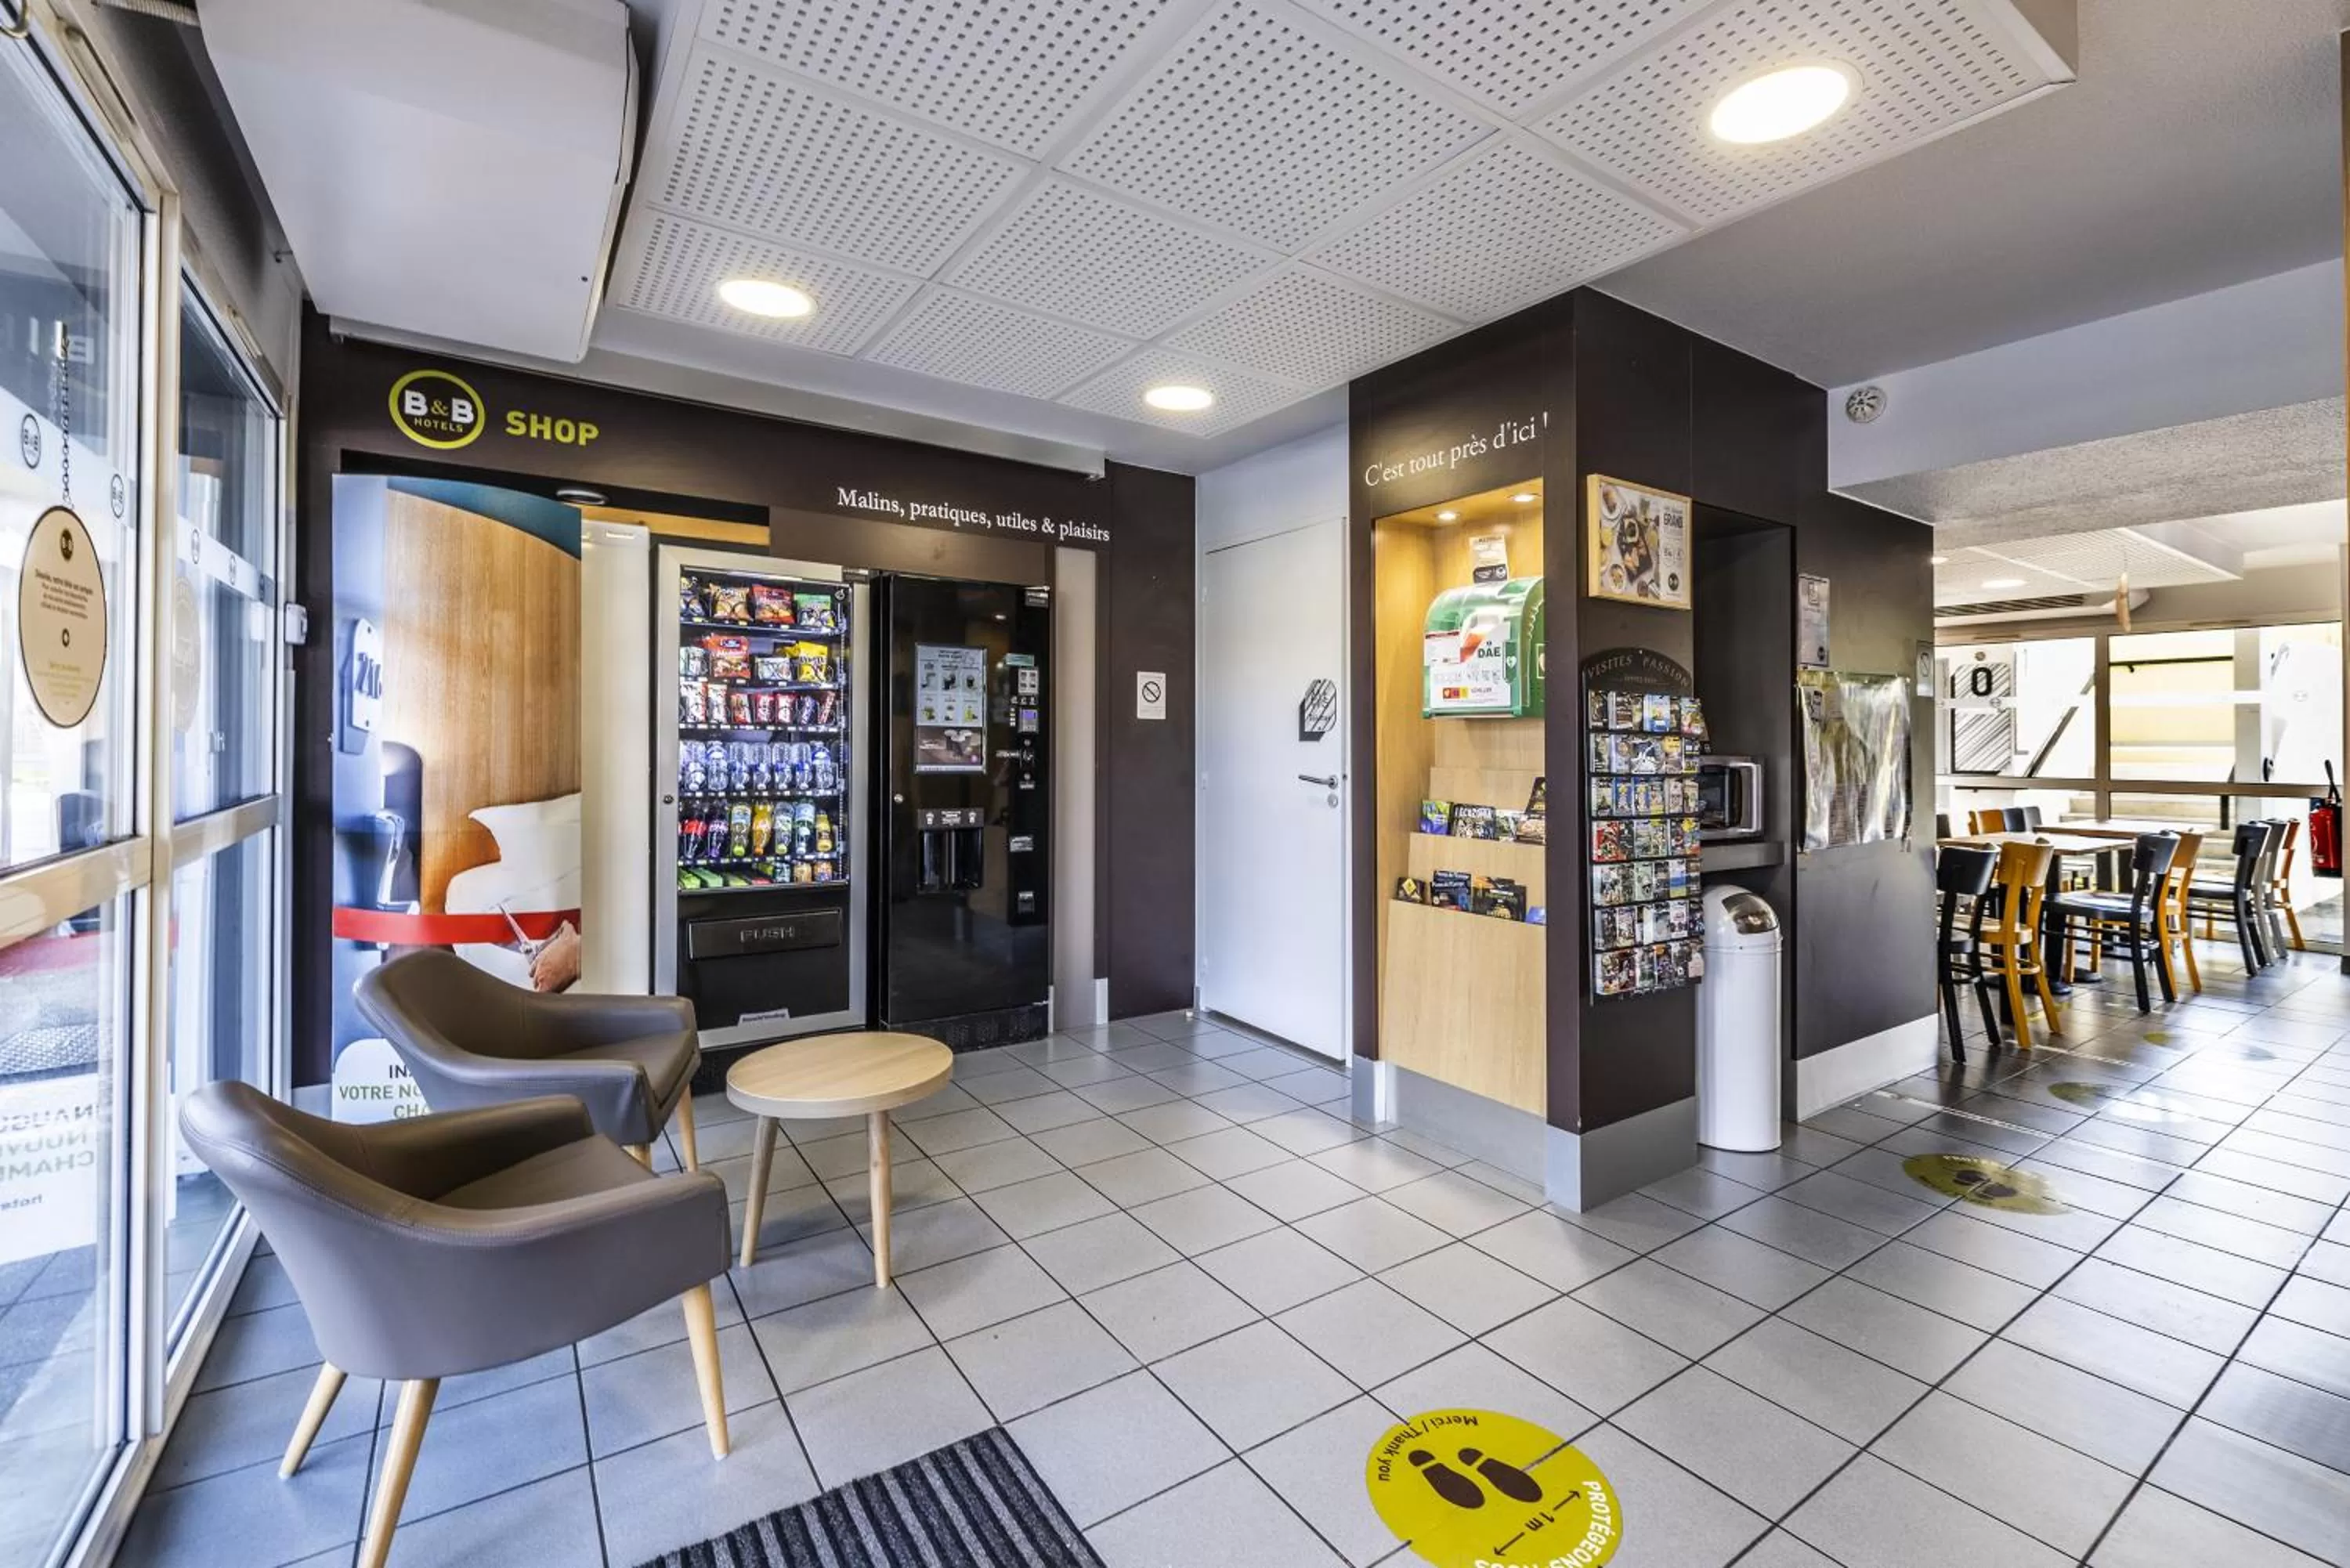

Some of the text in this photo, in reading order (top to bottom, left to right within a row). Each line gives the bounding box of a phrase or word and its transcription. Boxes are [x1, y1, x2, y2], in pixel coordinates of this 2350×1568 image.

[404, 389, 474, 424] B&B
[414, 417, 463, 433] HOTELS
[505, 410, 599, 446] SHOP
[1365, 462, 1405, 486] C'est
[1410, 450, 1445, 474] tout
[1450, 434, 1487, 468] près
[1492, 416, 1537, 449] d'ici
[837, 486, 1111, 542] Malins, pratiques, utiles & plaisirs
[1477, 647, 1502, 659] DAE
[1587, 654, 1689, 687] VISITES PASSION
[740, 926, 796, 943] PUSH
[389, 1064, 414, 1078] IN
[339, 1086, 394, 1100] VOTRE
[1376, 1457, 1393, 1482] you
